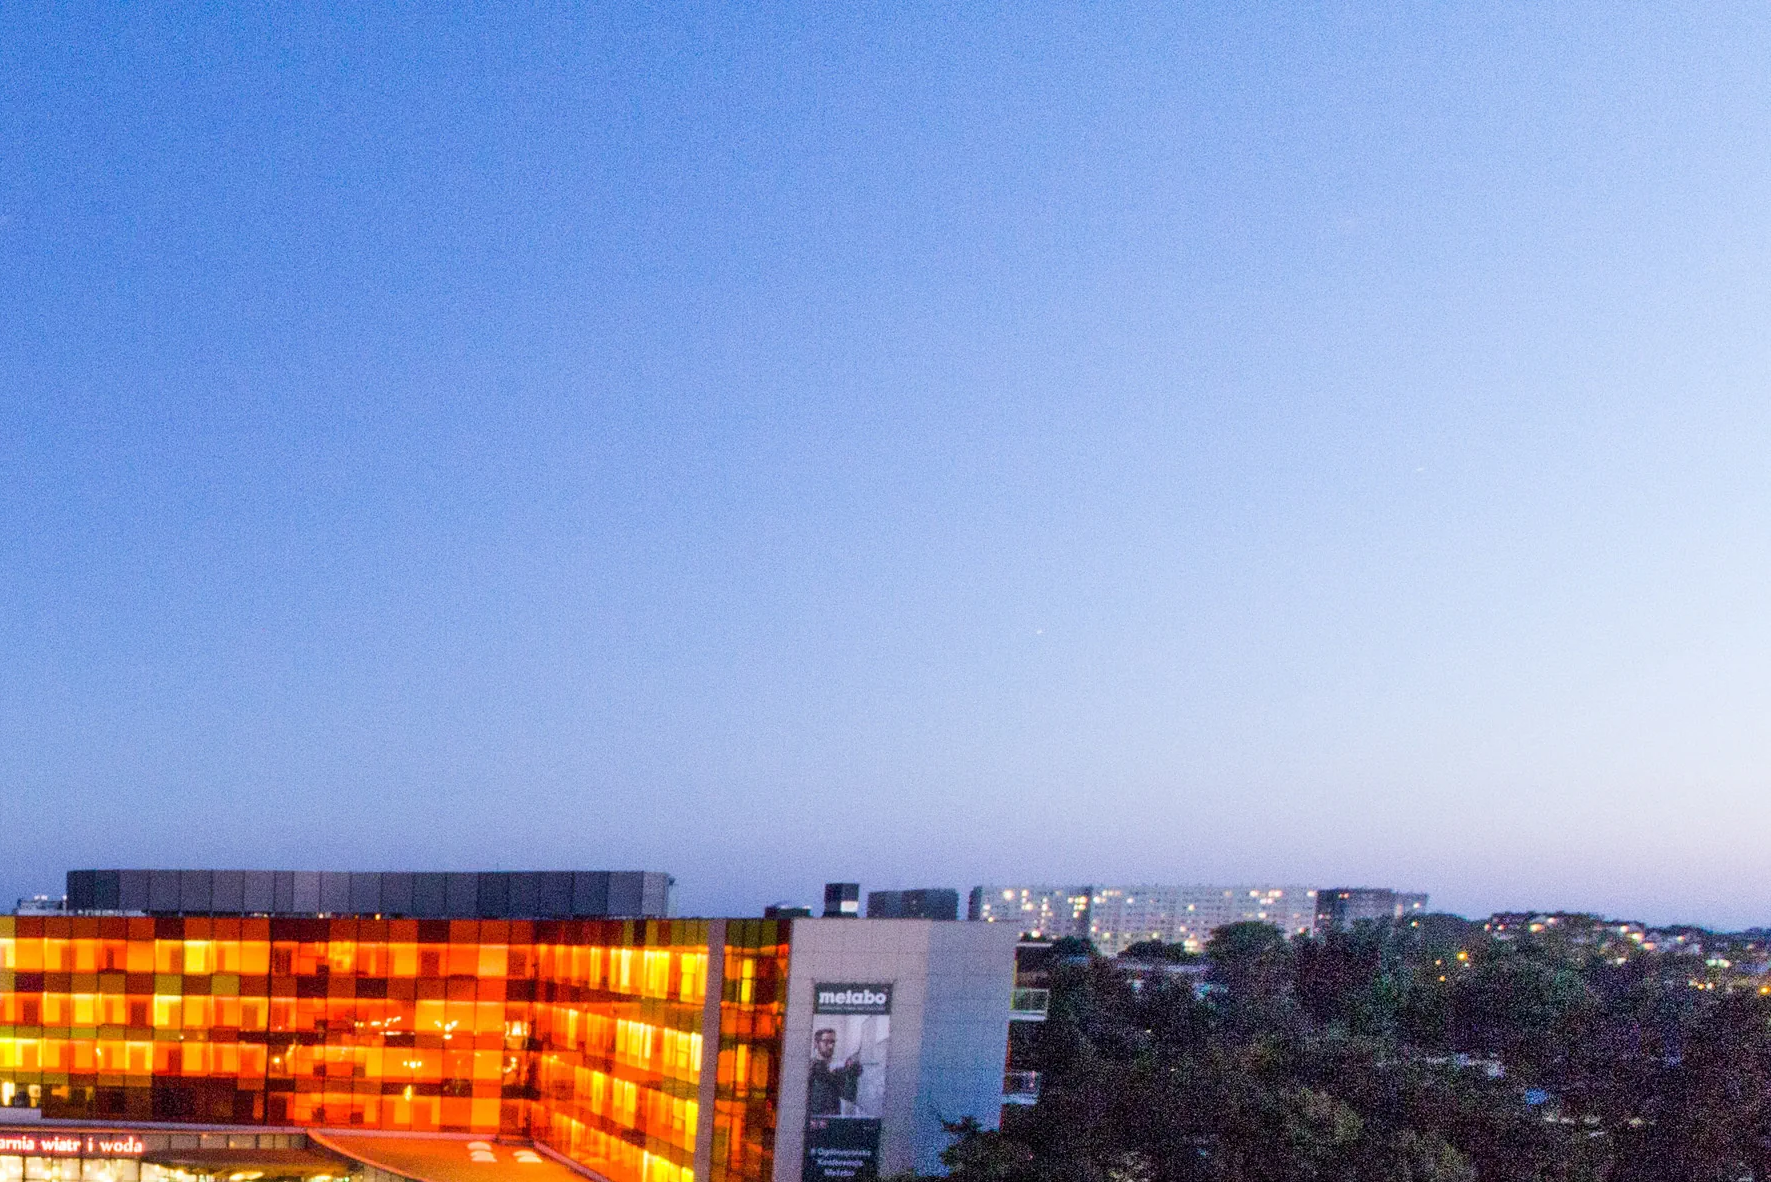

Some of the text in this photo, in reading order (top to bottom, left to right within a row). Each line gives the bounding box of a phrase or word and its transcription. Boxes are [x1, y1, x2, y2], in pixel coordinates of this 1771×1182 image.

[819, 989, 886, 1005] metabo
[40, 1136, 81, 1152] wiatr
[87, 1137, 93, 1152] i
[99, 1136, 143, 1153] woda
